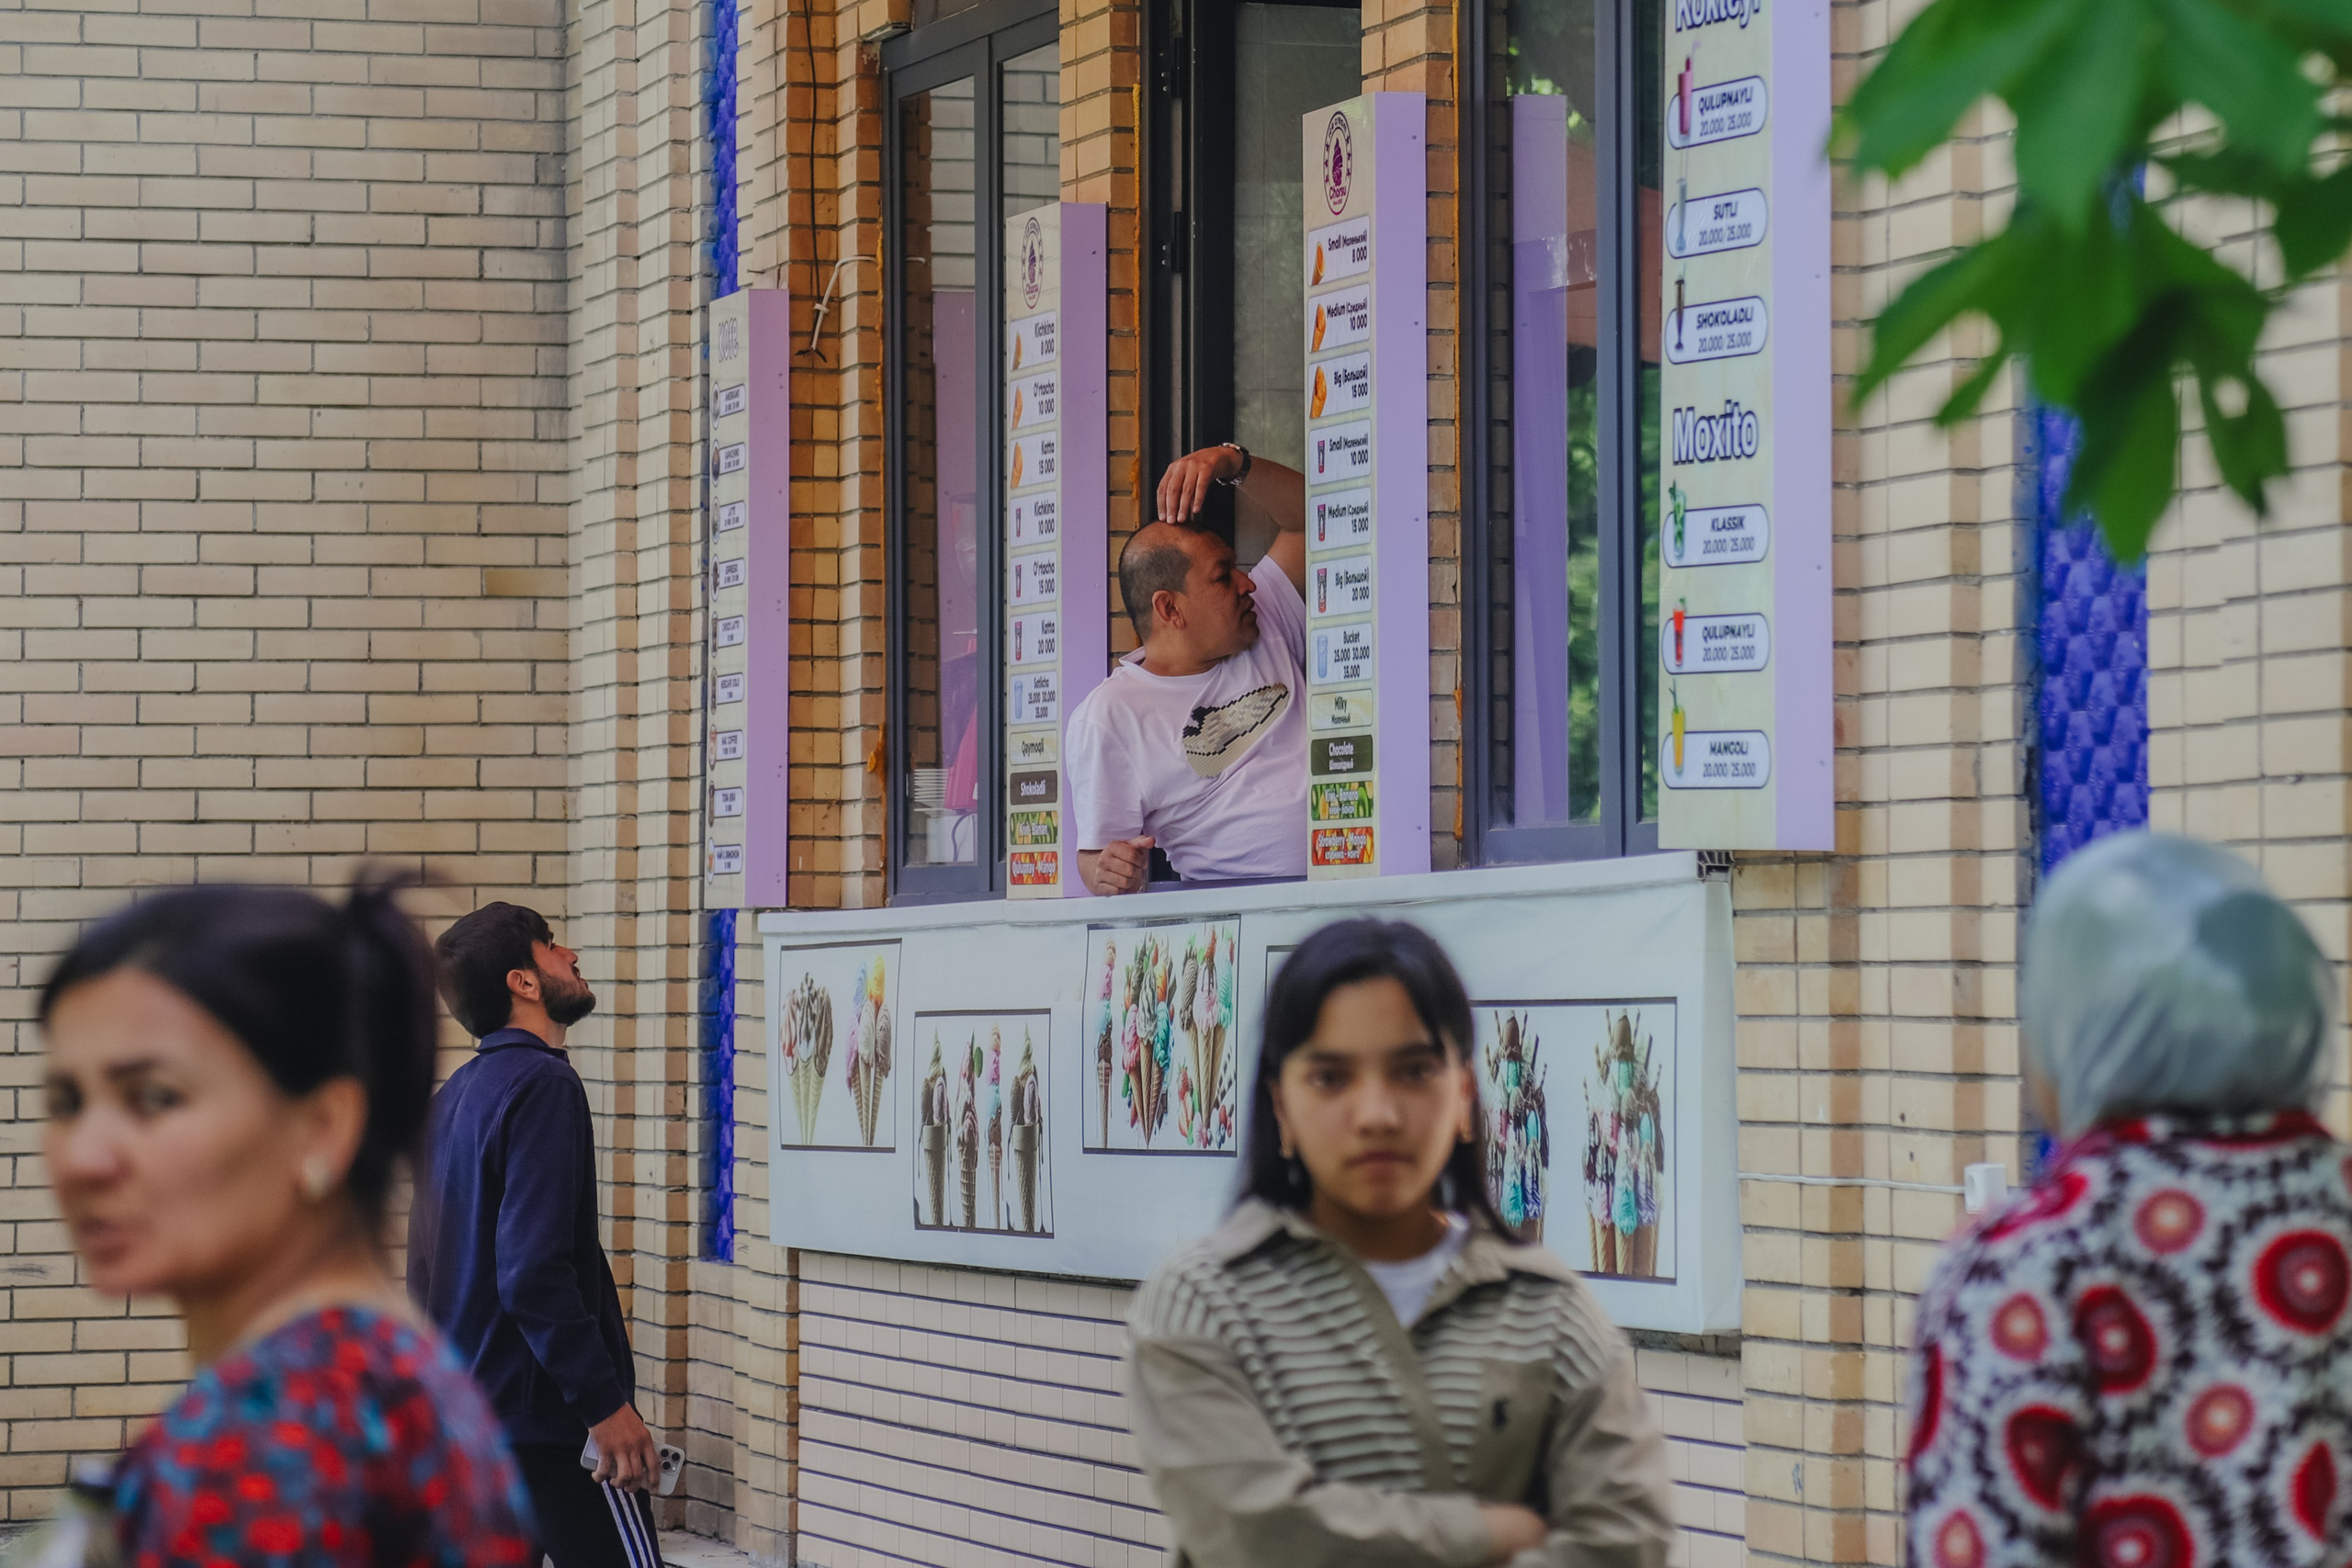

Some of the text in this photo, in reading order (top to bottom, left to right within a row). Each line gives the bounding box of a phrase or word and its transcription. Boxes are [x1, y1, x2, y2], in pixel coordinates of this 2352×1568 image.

[1698, 86, 1754, 116] QULUPNAYLI
[1329, 185, 1347, 200] Chorsu
[1713, 201, 1738, 220] SUTLI
[1328, 234, 1341, 252] Small
[1356, 245, 1368, 261] 000
[1327, 302, 1346, 319] Medium
[1696, 307, 1755, 330] SHOKOLADLI
[1035, 321, 1055, 338] Kichkina
[1350, 313, 1368, 331] 10 000
[1045, 339, 1055, 354] 000
[1334, 371, 1342, 388] Big
[1357, 382, 1368, 397] 000
[1038, 400, 1055, 415] 10 000
[1672, 400, 1759, 466] Moxito
[1041, 440, 1055, 456] Katta
[1329, 436, 1342, 452] Small
[1045, 458, 1055, 473] 000
[1351, 449, 1369, 466] 10 000
[1034, 500, 1055, 516] Kichkina
[1328, 504, 1347, 520] Medium
[1038, 518, 1055, 535] 10 000
[1358, 517, 1369, 532] 000
[1710, 515, 1746, 533] KLASSIK
[1045, 578, 1055, 592] 000
[1335, 572, 1343, 589] Big
[1359, 585, 1370, 601] 000
[1041, 620, 1055, 635] Katta
[1702, 624, 1755, 643] QULUPNAYLI
[1045, 638, 1055, 653] 000
[1343, 631, 1360, 645] Bucket
[1351, 646, 1370, 660] 30.000
[1334, 696, 1348, 713] Milky
[1022, 738, 1045, 757] Qaymoqli
[1329, 741, 1354, 757] Chocolate
[1709, 740, 1748, 756] MANGOLI
[1020, 779, 1046, 796] Shokoladli
[1340, 788, 1359, 801] Banana
[1317, 833, 1346, 849] Strawberry
[1012, 861, 1035, 876] Qulupnay
